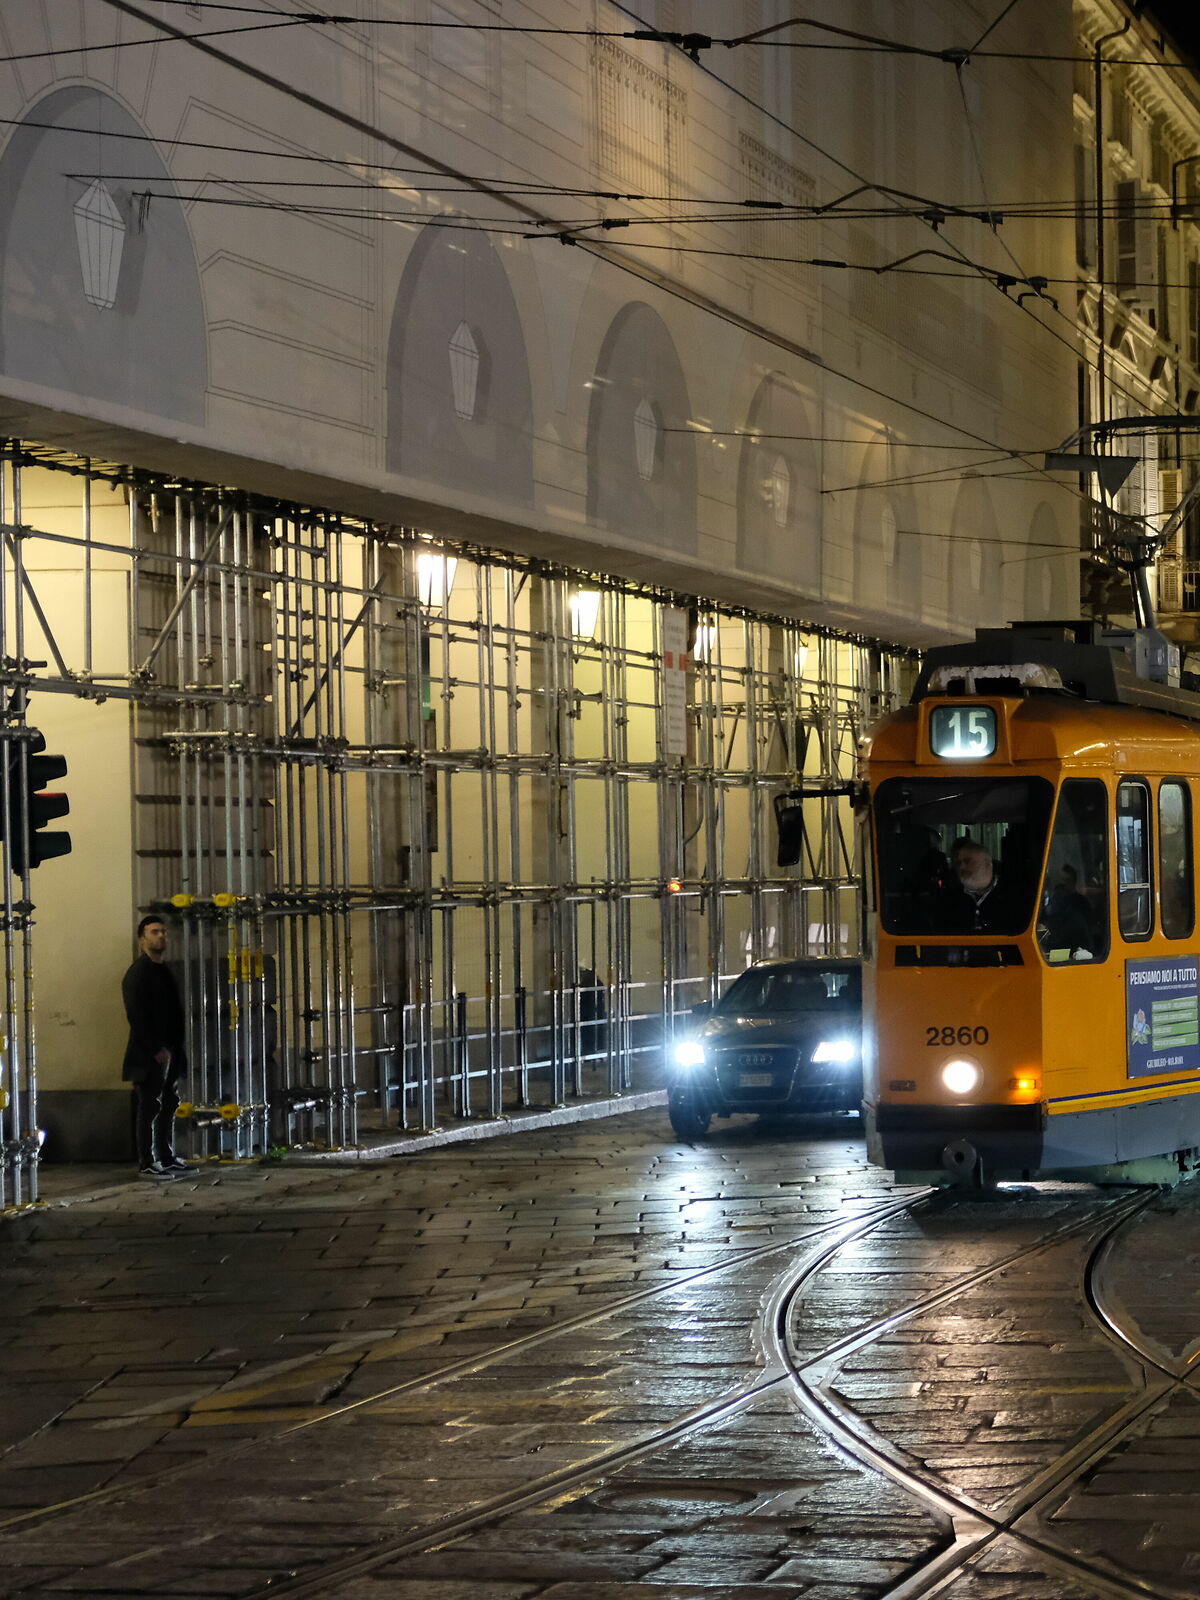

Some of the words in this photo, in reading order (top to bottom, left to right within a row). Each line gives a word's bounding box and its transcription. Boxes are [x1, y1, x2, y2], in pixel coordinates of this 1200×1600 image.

[948, 711, 988, 752] 15
[1130, 970, 1161, 985] PENSIAMO
[1161, 969, 1173, 983] NOI
[1173, 968, 1178, 982] A
[1178, 967, 1197, 982] TUTTO
[926, 1026, 989, 1046] 2860
